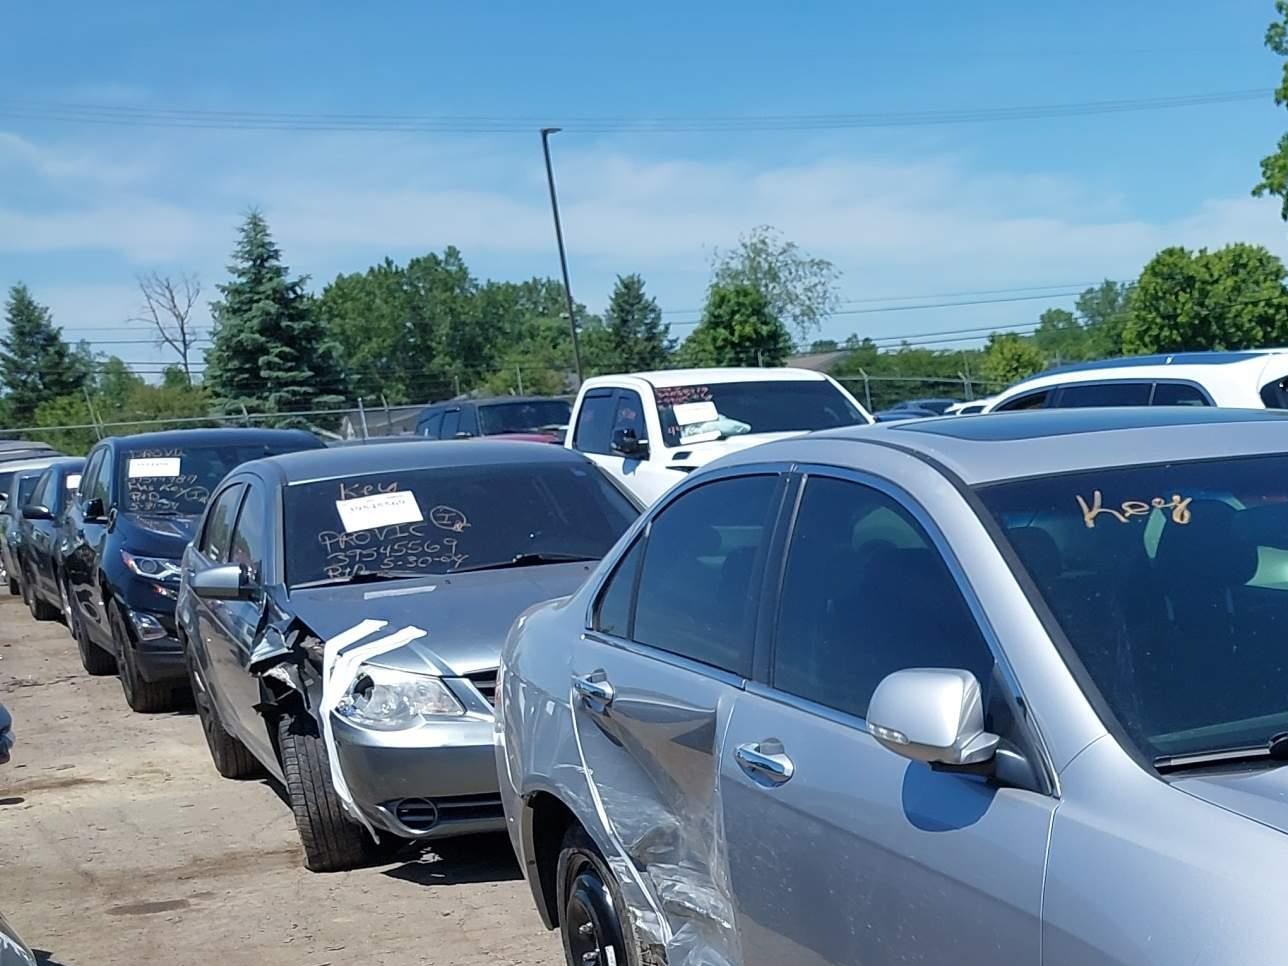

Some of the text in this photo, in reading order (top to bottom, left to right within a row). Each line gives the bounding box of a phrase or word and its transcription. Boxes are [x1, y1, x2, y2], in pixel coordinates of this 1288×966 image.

[340, 482, 398, 500] Key
[1075, 490, 1193, 528] Key
[318, 523, 428, 552] PROVIC
